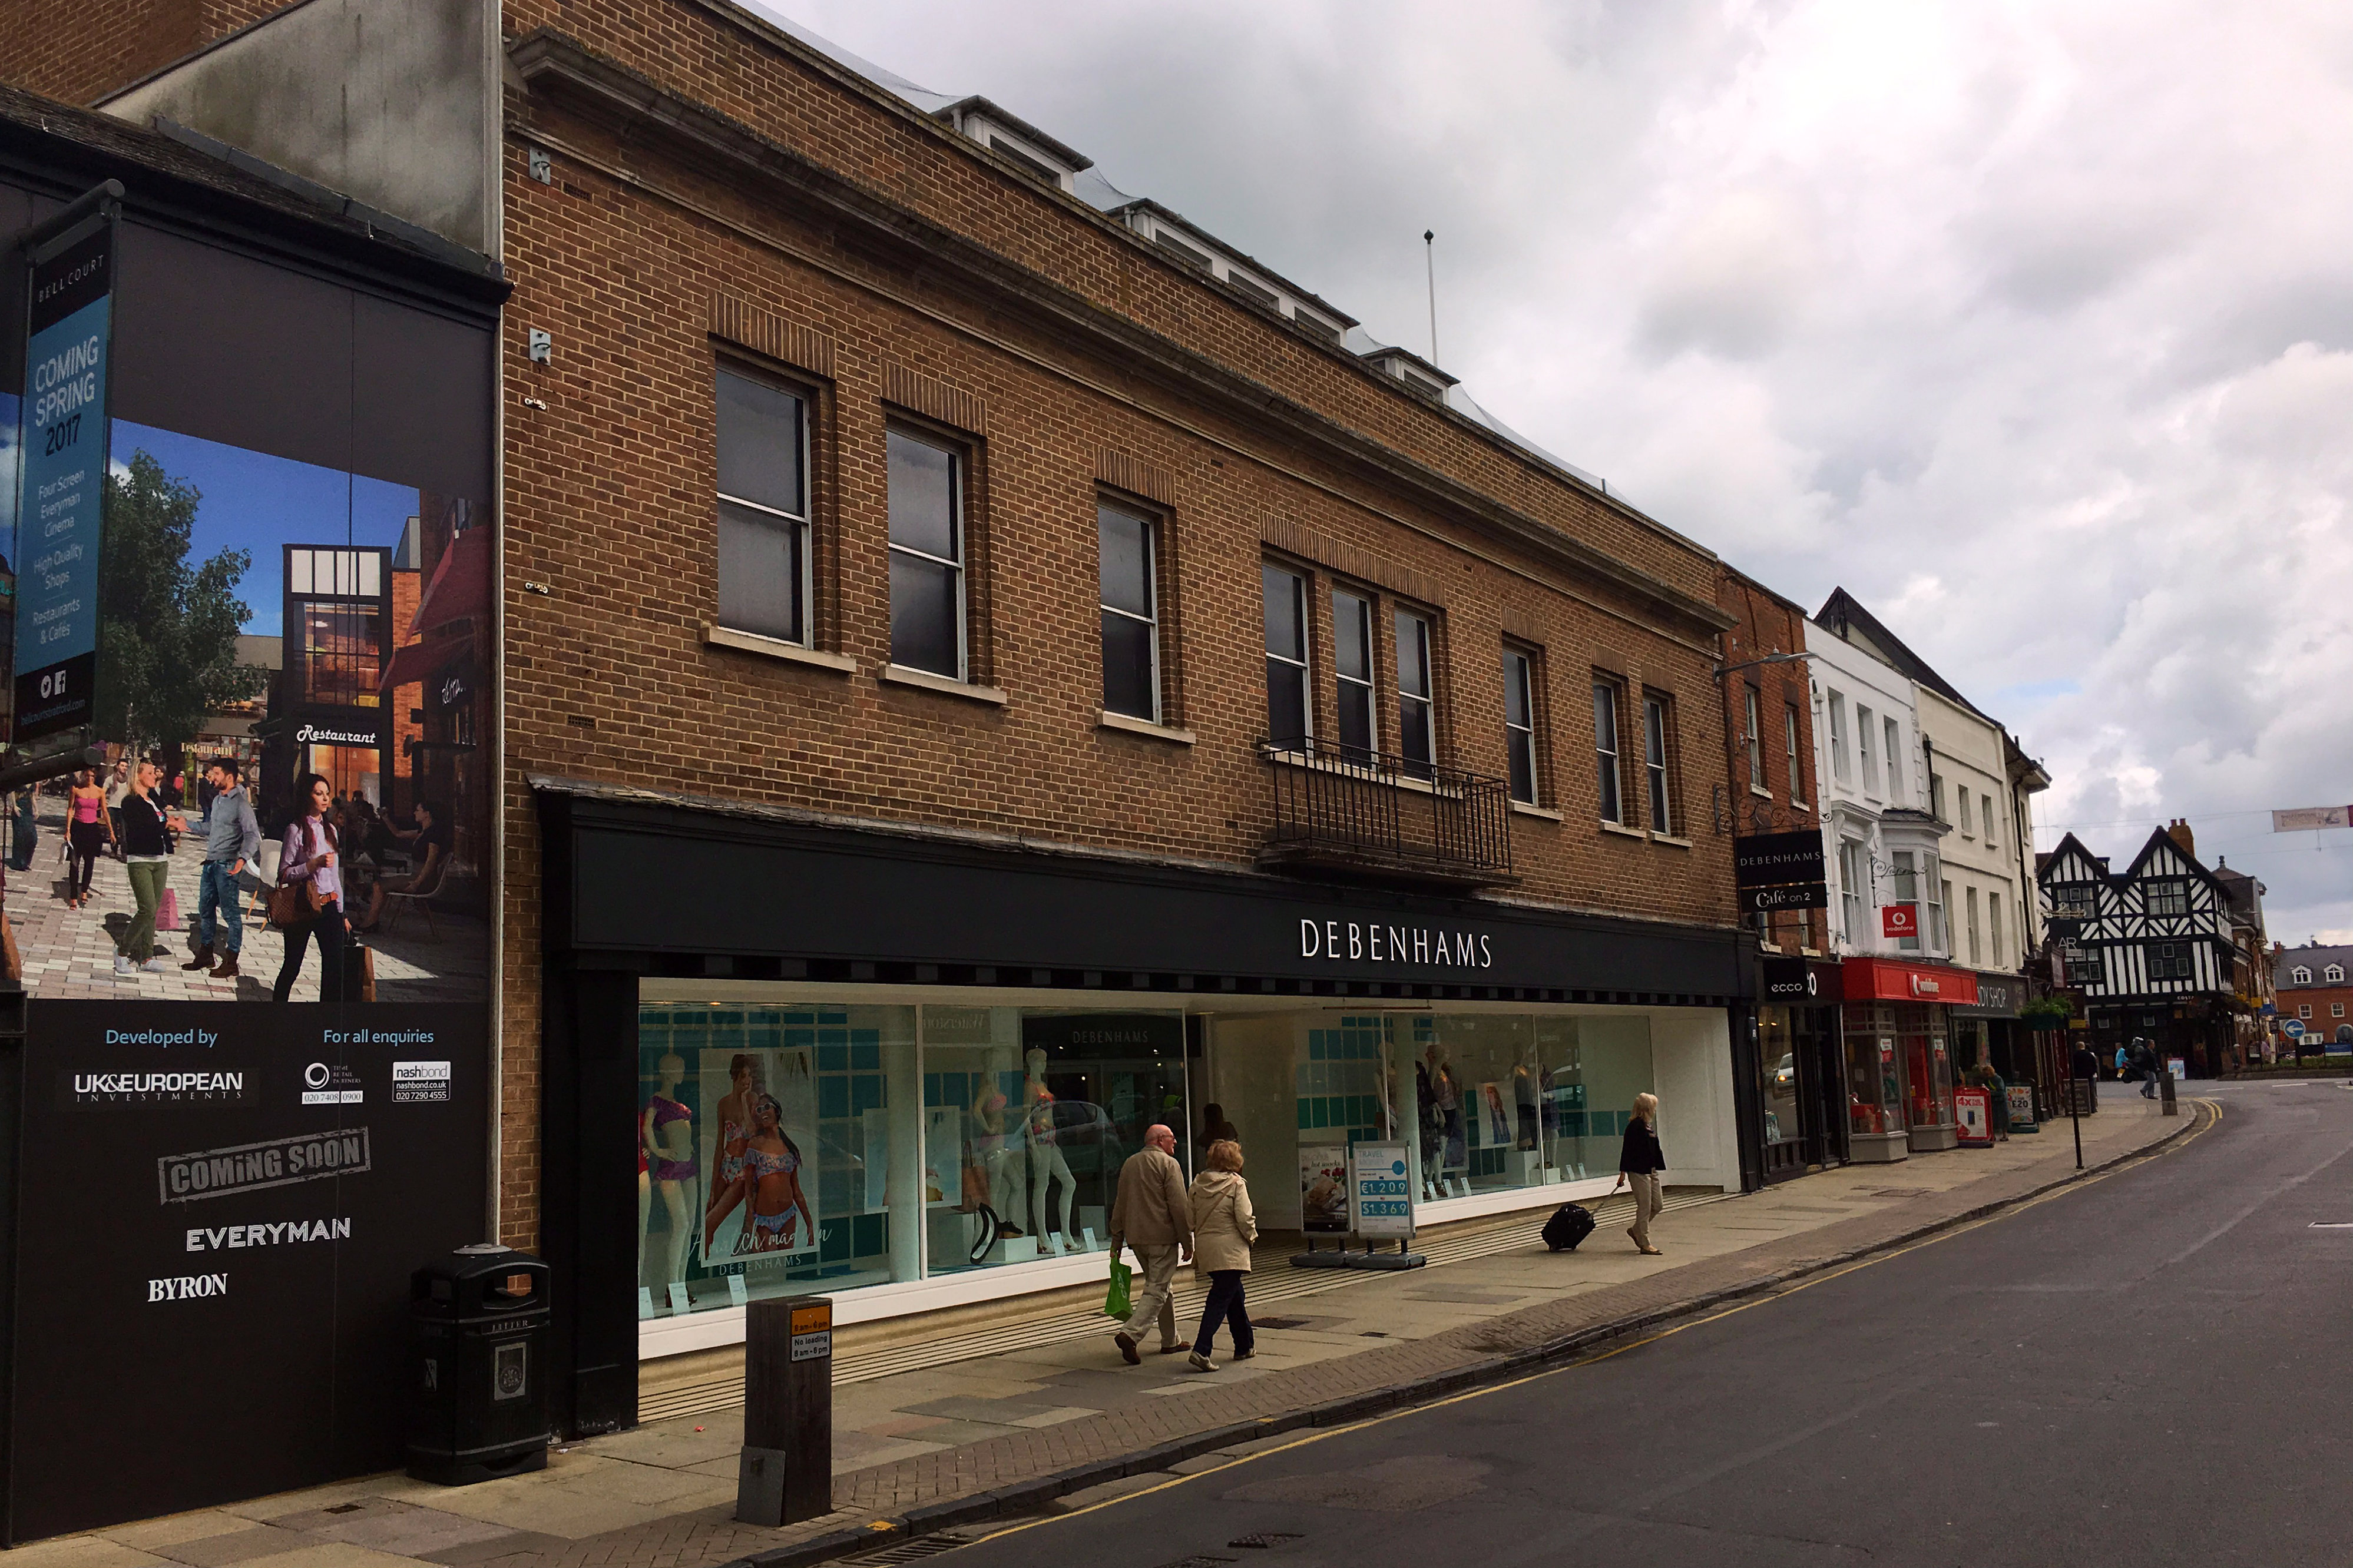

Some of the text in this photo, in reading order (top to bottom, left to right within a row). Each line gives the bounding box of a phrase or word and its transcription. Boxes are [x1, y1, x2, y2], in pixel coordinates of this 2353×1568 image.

[39, 255, 103, 303] BELL COURT
[35, 335, 98, 392] COMING
[35, 372, 95, 427] SPRING
[45, 413, 81, 457] 2017
[39, 470, 85, 500] Four Screen
[40, 493, 81, 519] Everyman
[45, 515, 75, 538] Cinema
[34, 543, 84, 575] High Quality
[45, 569, 70, 590] Shops
[33, 597, 81, 626] Restaurants
[40, 632, 47, 644] &
[297, 724, 376, 744] Restaurant
[1740, 851, 1821, 866] DEBENHAMS
[1756, 890, 1786, 908] Café
[1804, 892, 1811, 901] 2
[1300, 919, 1491, 967] DEBENHAMS
[1772, 983, 1803, 992] ecco
[105, 1029, 218, 1049] Developed by
[323, 1029, 434, 1047] For all enquiries
[1073, 1030, 1148, 1043] DEBENHAMS
[396, 1065, 447, 1078] nashbond
[396, 1081, 446, 1089] nashbond.co.uk
[396, 1091, 447, 1100] 020 7290 4555
[77, 1091, 242, 1103] INVESTMENTS
[321, 1093, 339, 1102] 7408
[342, 1093, 361, 1101] 0900
[288, 1137, 360, 1173] SOON
[186, 1217, 351, 1252] EVERYMAN
[719, 1254, 802, 1275] DEBENHAMS
[147, 1273, 228, 1302] BYRON
[805, 1335, 828, 1344] loading
